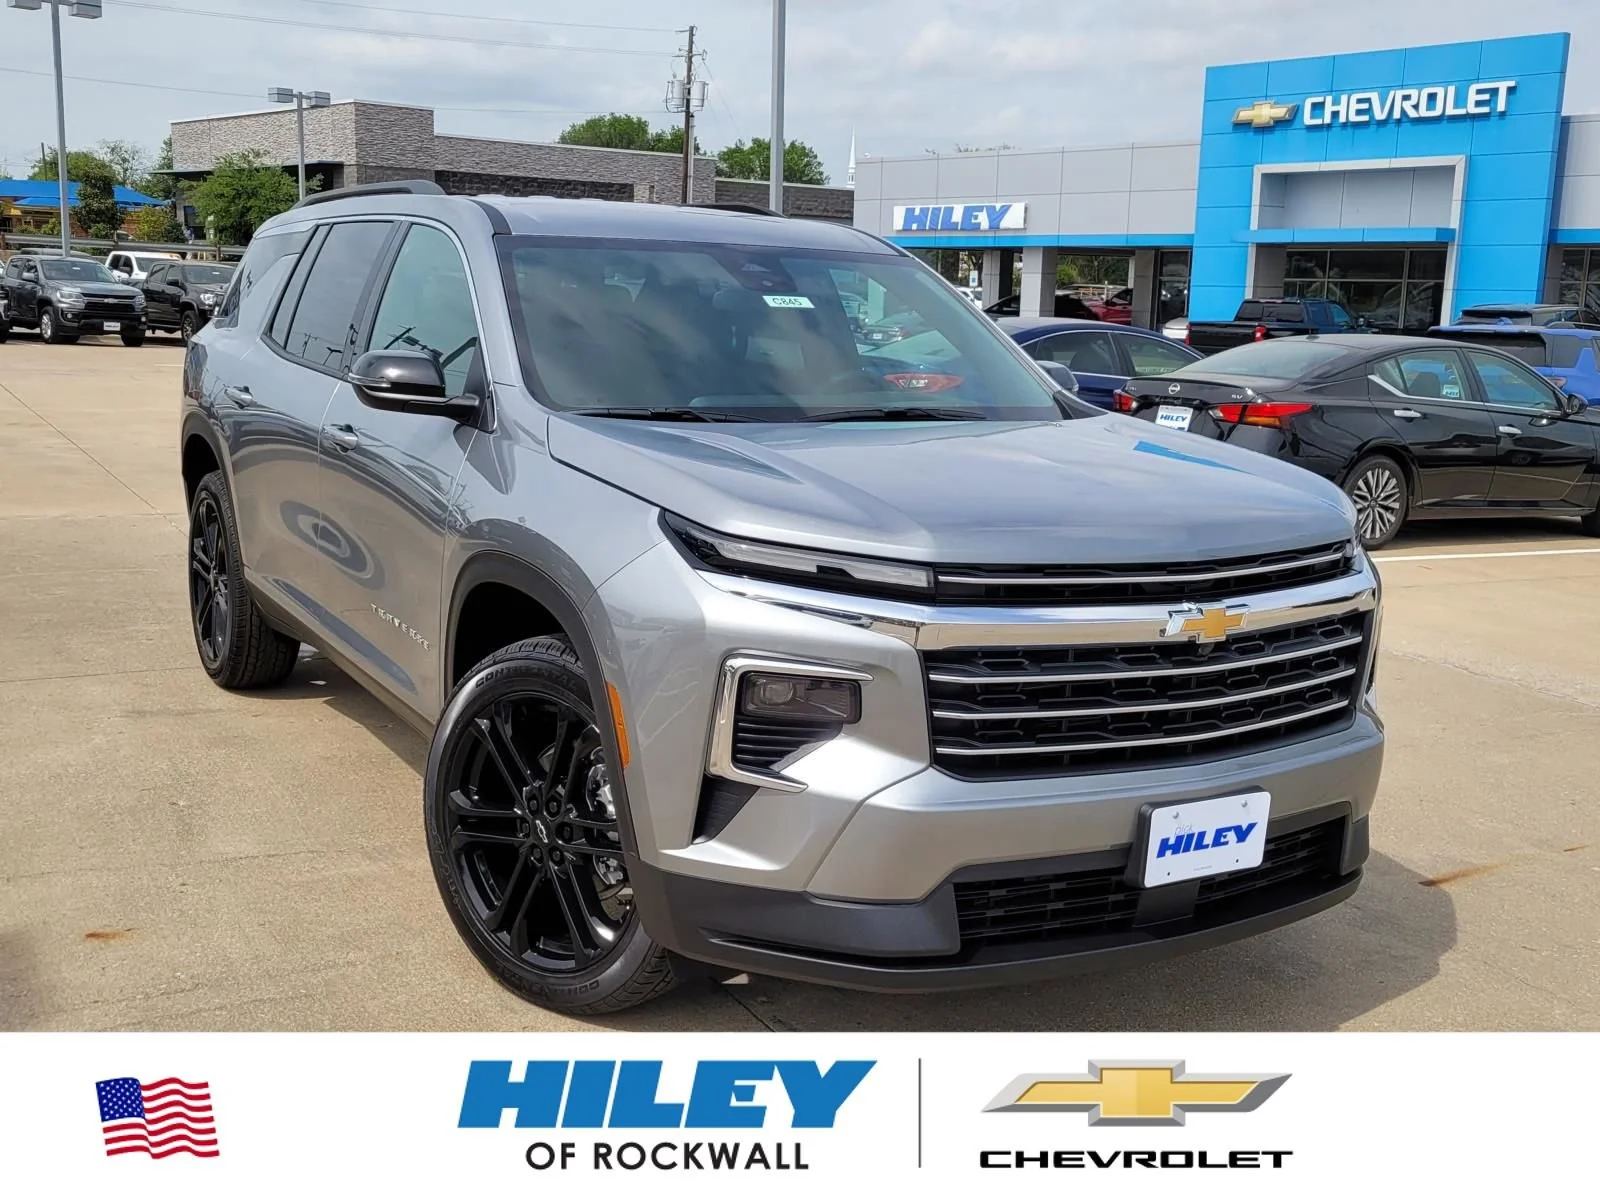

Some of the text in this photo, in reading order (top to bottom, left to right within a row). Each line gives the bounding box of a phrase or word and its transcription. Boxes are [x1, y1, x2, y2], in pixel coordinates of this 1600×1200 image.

[1303, 81, 1516, 126] CHEVROLET
[902, 204, 1012, 231] HILEY
[1160, 414, 1187, 422] HILEY
[1156, 822, 1258, 858] HILEY
